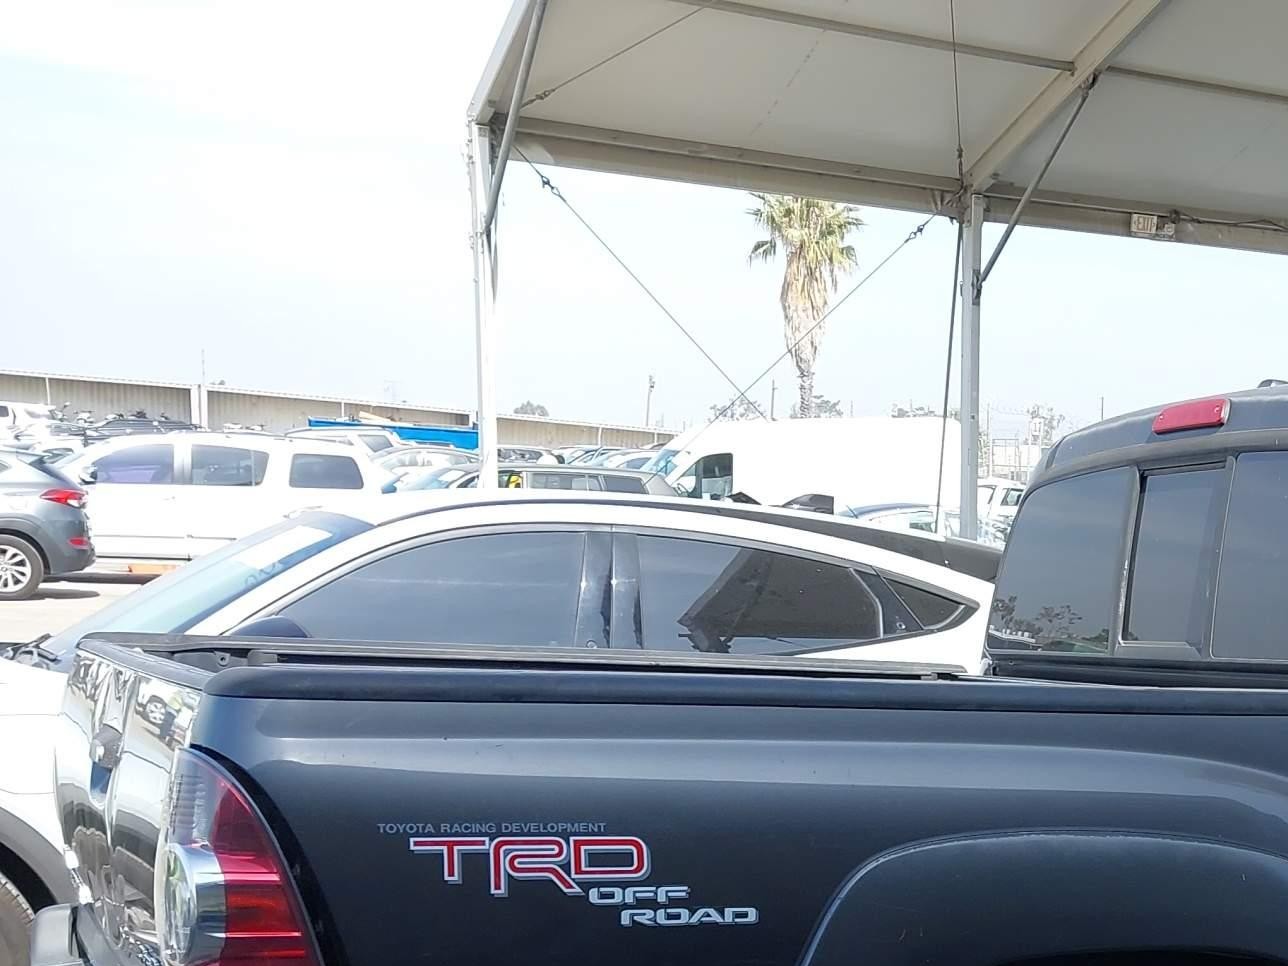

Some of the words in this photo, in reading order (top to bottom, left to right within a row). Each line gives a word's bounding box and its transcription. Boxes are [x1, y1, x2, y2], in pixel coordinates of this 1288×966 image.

[1137, 216, 1154, 232] EXIT
[377, 823, 435, 834] TOYOTA
[440, 823, 497, 833] RACING
[501, 822, 607, 833] DEVELOPMENT
[409, 836, 652, 898] TRD
[588, 885, 691, 906] OFF
[620, 906, 760, 927] ROAD
